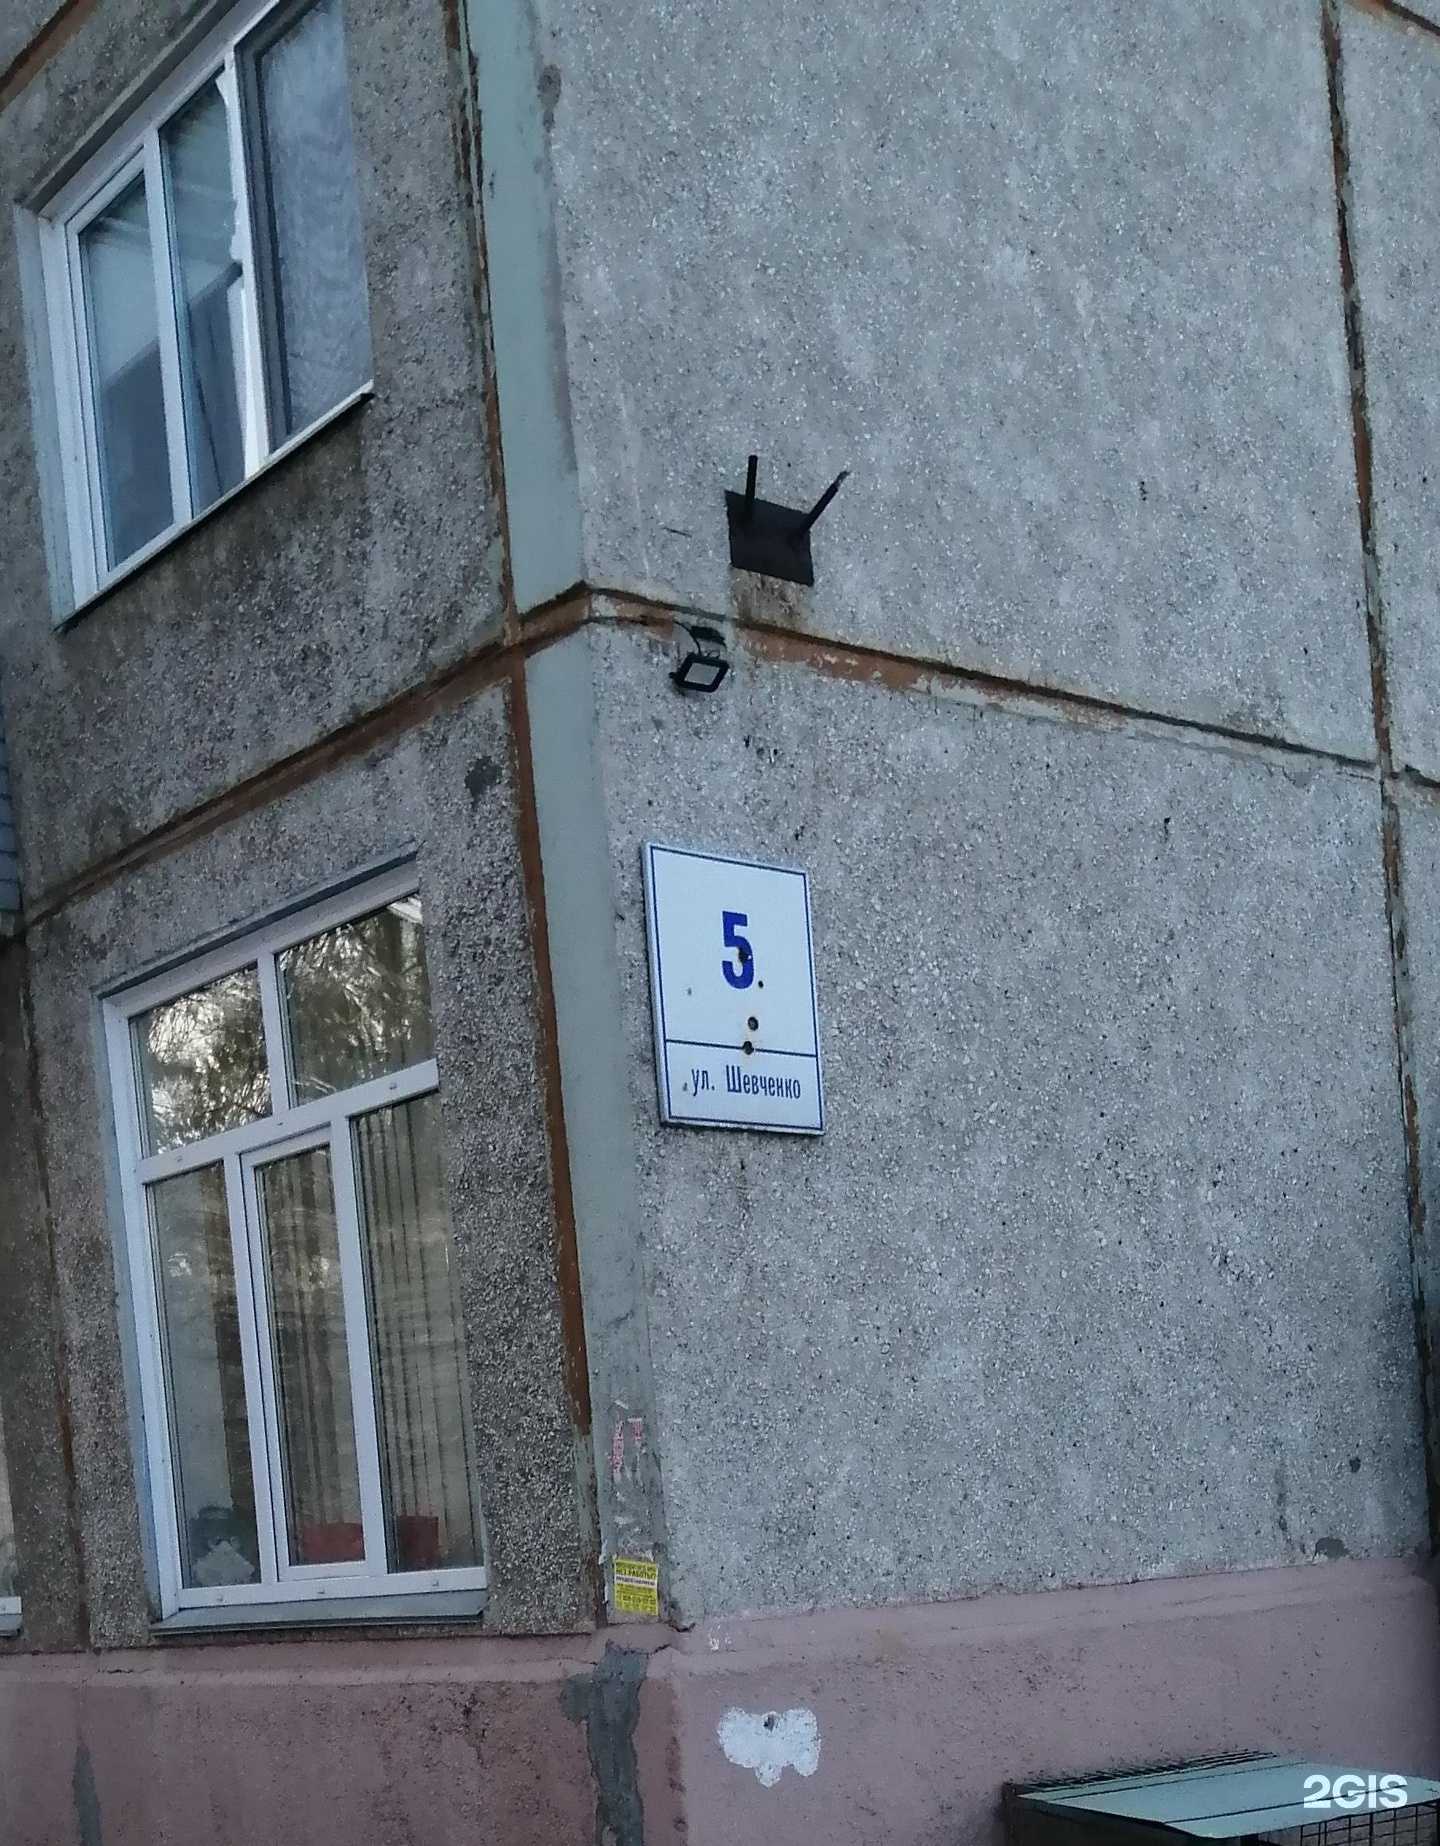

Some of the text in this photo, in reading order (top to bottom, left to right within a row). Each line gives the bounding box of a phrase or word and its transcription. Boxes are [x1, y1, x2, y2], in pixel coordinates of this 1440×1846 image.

[722, 912, 754, 989] 5
[691, 1066, 801, 1099] ул. Шевченко
